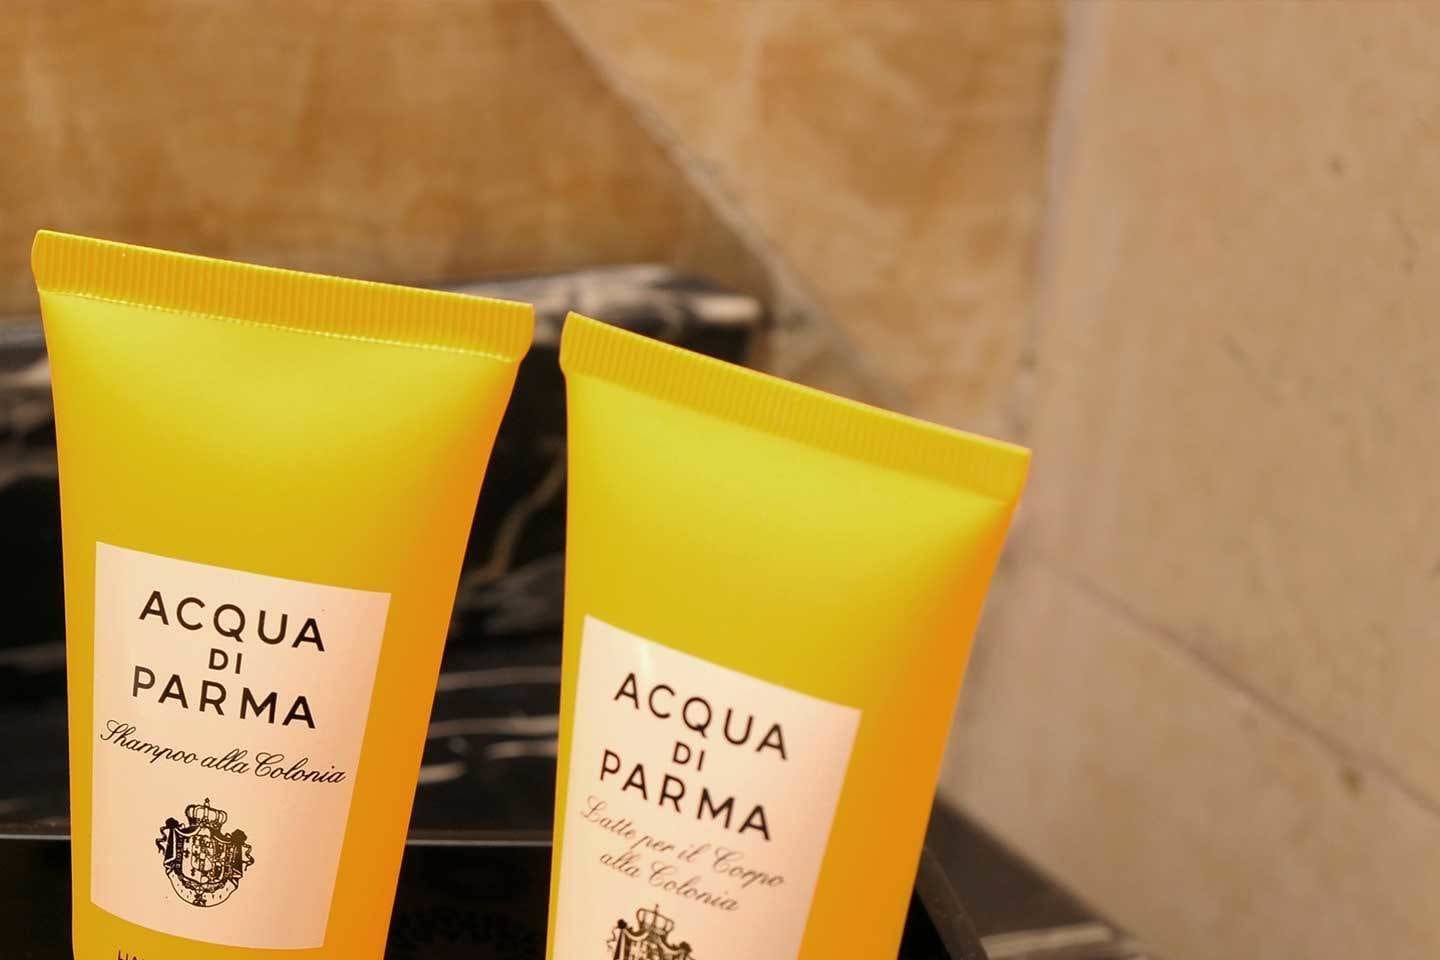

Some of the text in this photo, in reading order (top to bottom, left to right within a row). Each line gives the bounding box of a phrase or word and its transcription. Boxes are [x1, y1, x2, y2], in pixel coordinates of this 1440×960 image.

[139, 590, 325, 652] ACQUA
[208, 648, 242, 675] DI
[132, 665, 316, 729] PARMA
[613, 672, 789, 761] ACQUA
[100, 719, 346, 784] Shampoo alla Colonia
[672, 741, 705, 772] DI
[599, 749, 771, 841] PARMA
[581, 796, 785, 889] Latte per il Corpo
[599, 848, 739, 912] alla Colonia
